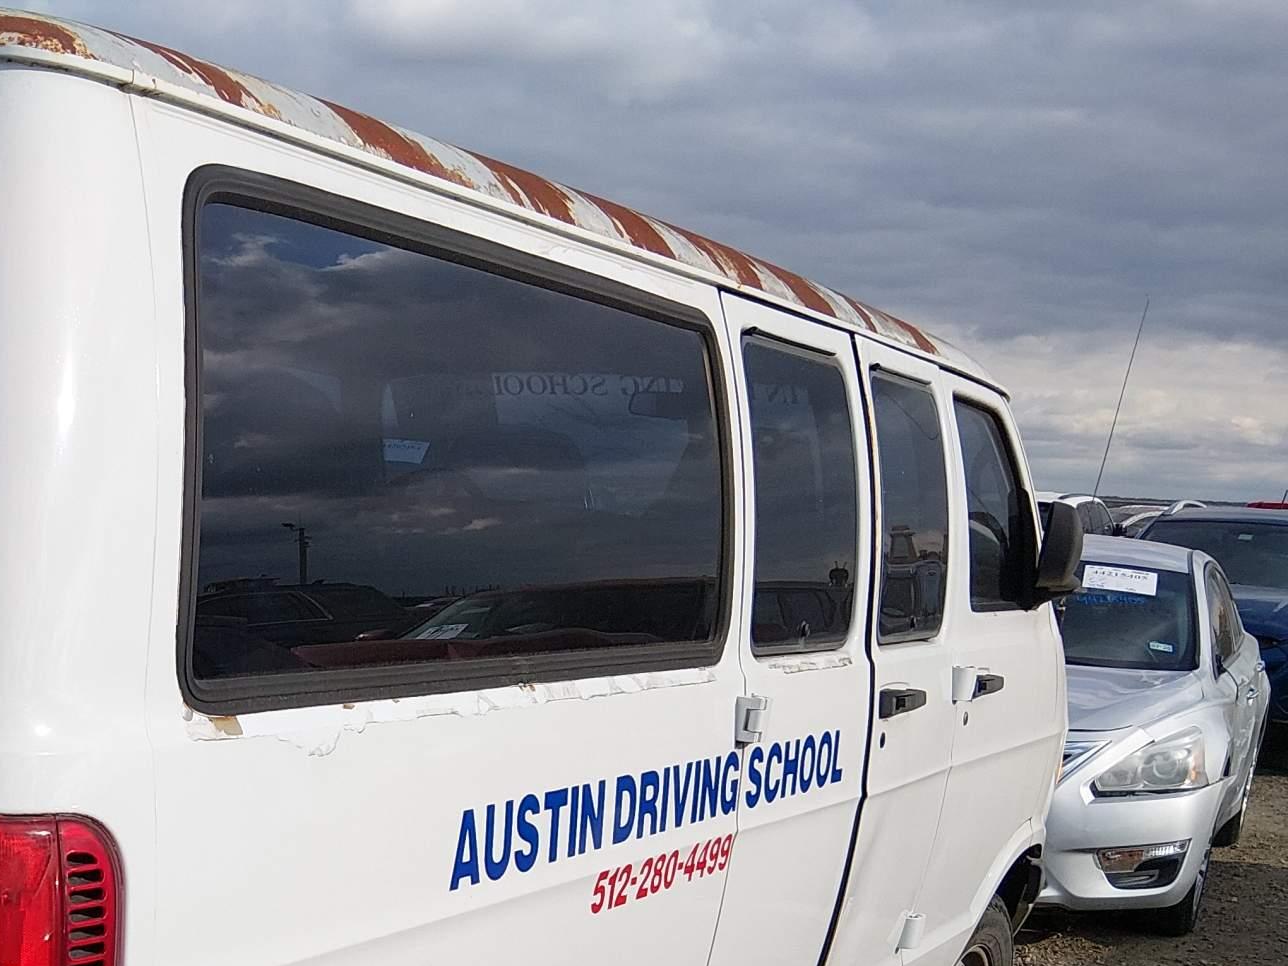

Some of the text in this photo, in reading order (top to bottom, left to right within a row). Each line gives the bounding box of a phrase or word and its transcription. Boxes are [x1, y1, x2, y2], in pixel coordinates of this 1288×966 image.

[449, 730, 843, 891] AUSTIN DRIVING SCHOOL
[590, 833, 734, 914] 512-280-4499
